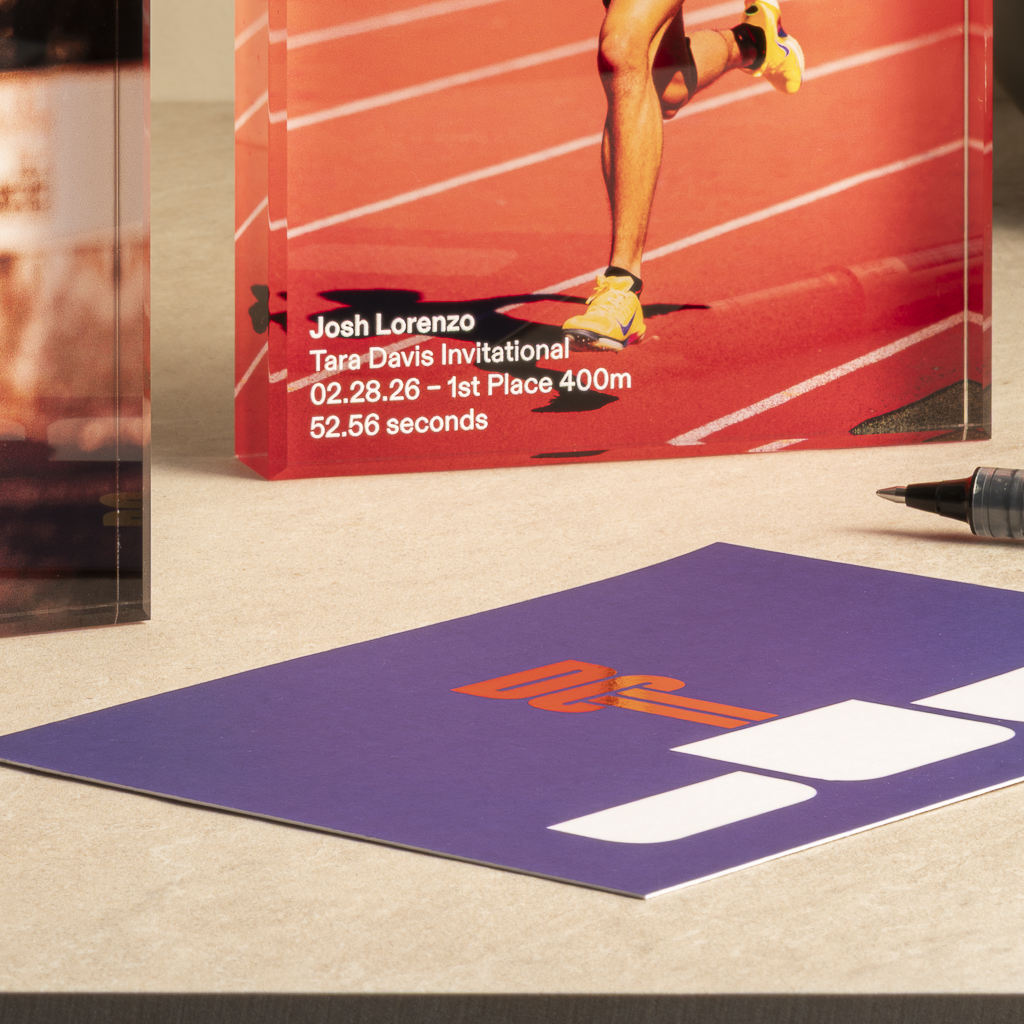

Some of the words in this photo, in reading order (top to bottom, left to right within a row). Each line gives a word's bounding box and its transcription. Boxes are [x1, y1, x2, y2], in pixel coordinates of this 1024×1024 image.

[309, 315, 369, 339] Josh
[375, 313, 476, 336] Lorenzo
[309, 349, 361, 372] Tara
[369, 346, 434, 369] Davis
[441, 337, 569, 365] Invitational
[309, 378, 420, 406] 02.28.26
[446, 375, 480, 398] 1st
[487, 373, 553, 396] Place
[559, 368, 632, 392] 400m
[309, 413, 380, 439] 52.56
[386, 409, 488, 436] seconds
